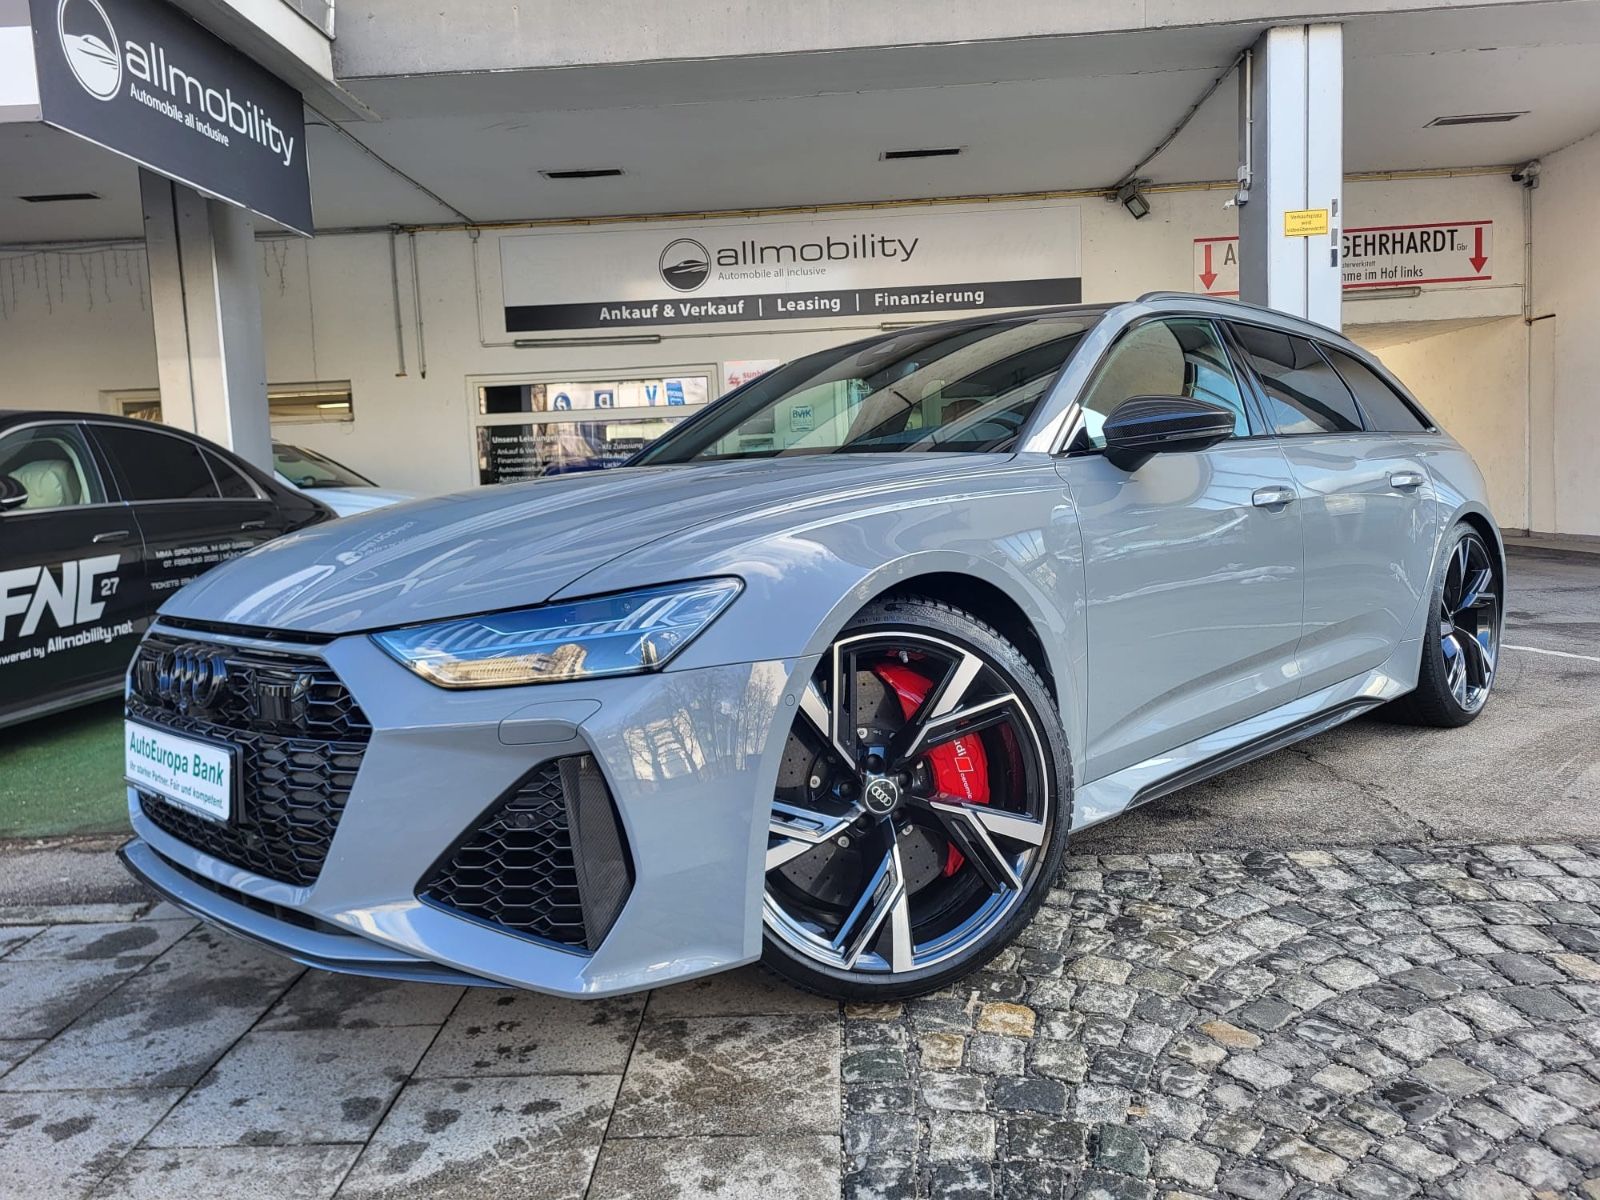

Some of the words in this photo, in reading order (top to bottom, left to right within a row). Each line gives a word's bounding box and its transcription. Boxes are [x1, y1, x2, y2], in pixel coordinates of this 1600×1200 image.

[125, 40, 294, 166] allmobility
[130, 83, 183, 123] Automobile
[184, 113, 195, 128] all
[196, 117, 230, 147] inclusive
[716, 233, 920, 267] allmobility
[1224, 243, 1237, 265] A
[1457, 243, 1468, 251] Gbr
[718, 268, 772, 281] Automobile
[773, 267, 785, 278] all
[787, 265, 827, 277] inclusive
[1365, 268, 1377, 281] im
[1381, 266, 1398, 279] Hof
[1400, 265, 1423, 278] links
[599, 305, 659, 321] Ankauf
[663, 304, 675, 318] &
[680, 300, 745, 316] Verkauf
[777, 297, 841, 313] Leasing
[874, 289, 985, 307] Finanzierung
[492, 436, 518, 444] Unsere
[101, 577, 119, 596] 27
[151, 579, 179, 591] TICKETS
[33, 647, 45, 659] by
[47, 620, 133, 653] Allmobility.net
[130, 731, 188, 776] AutoEuropa
[193, 753, 224, 787] Bank
[170, 778, 180, 791] Fair
[181, 785, 192, 797] und
